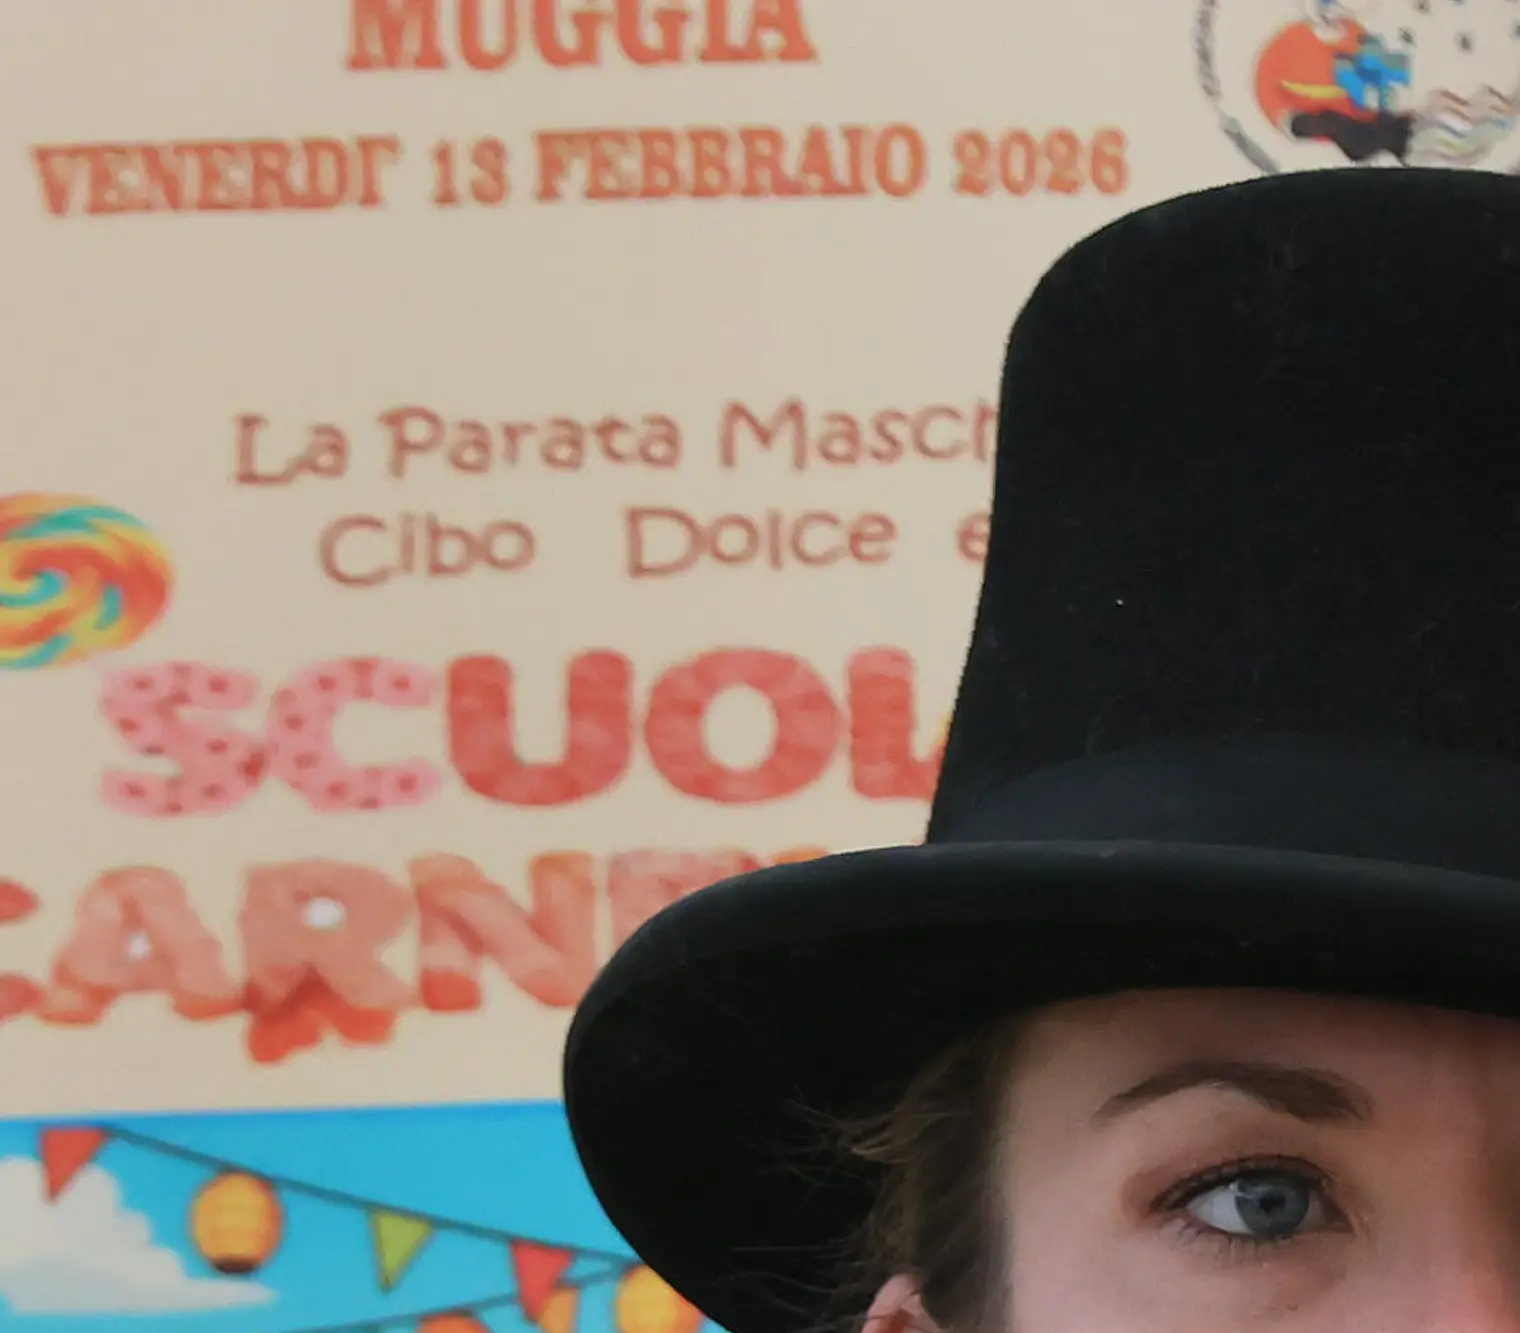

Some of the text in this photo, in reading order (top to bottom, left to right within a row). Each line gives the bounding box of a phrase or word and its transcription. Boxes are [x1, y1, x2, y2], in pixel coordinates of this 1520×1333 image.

[345, 0, 817, 71] MUGGIA
[428, 137, 511, 207] 13
[530, 124, 928, 203] FEBBRAIO
[950, 129, 1130, 197] 2026
[231, 412, 350, 487] La
[376, 403, 683, 479] Parata
[317, 512, 537, 588] Cibo
[625, 505, 898, 579] Dolce
